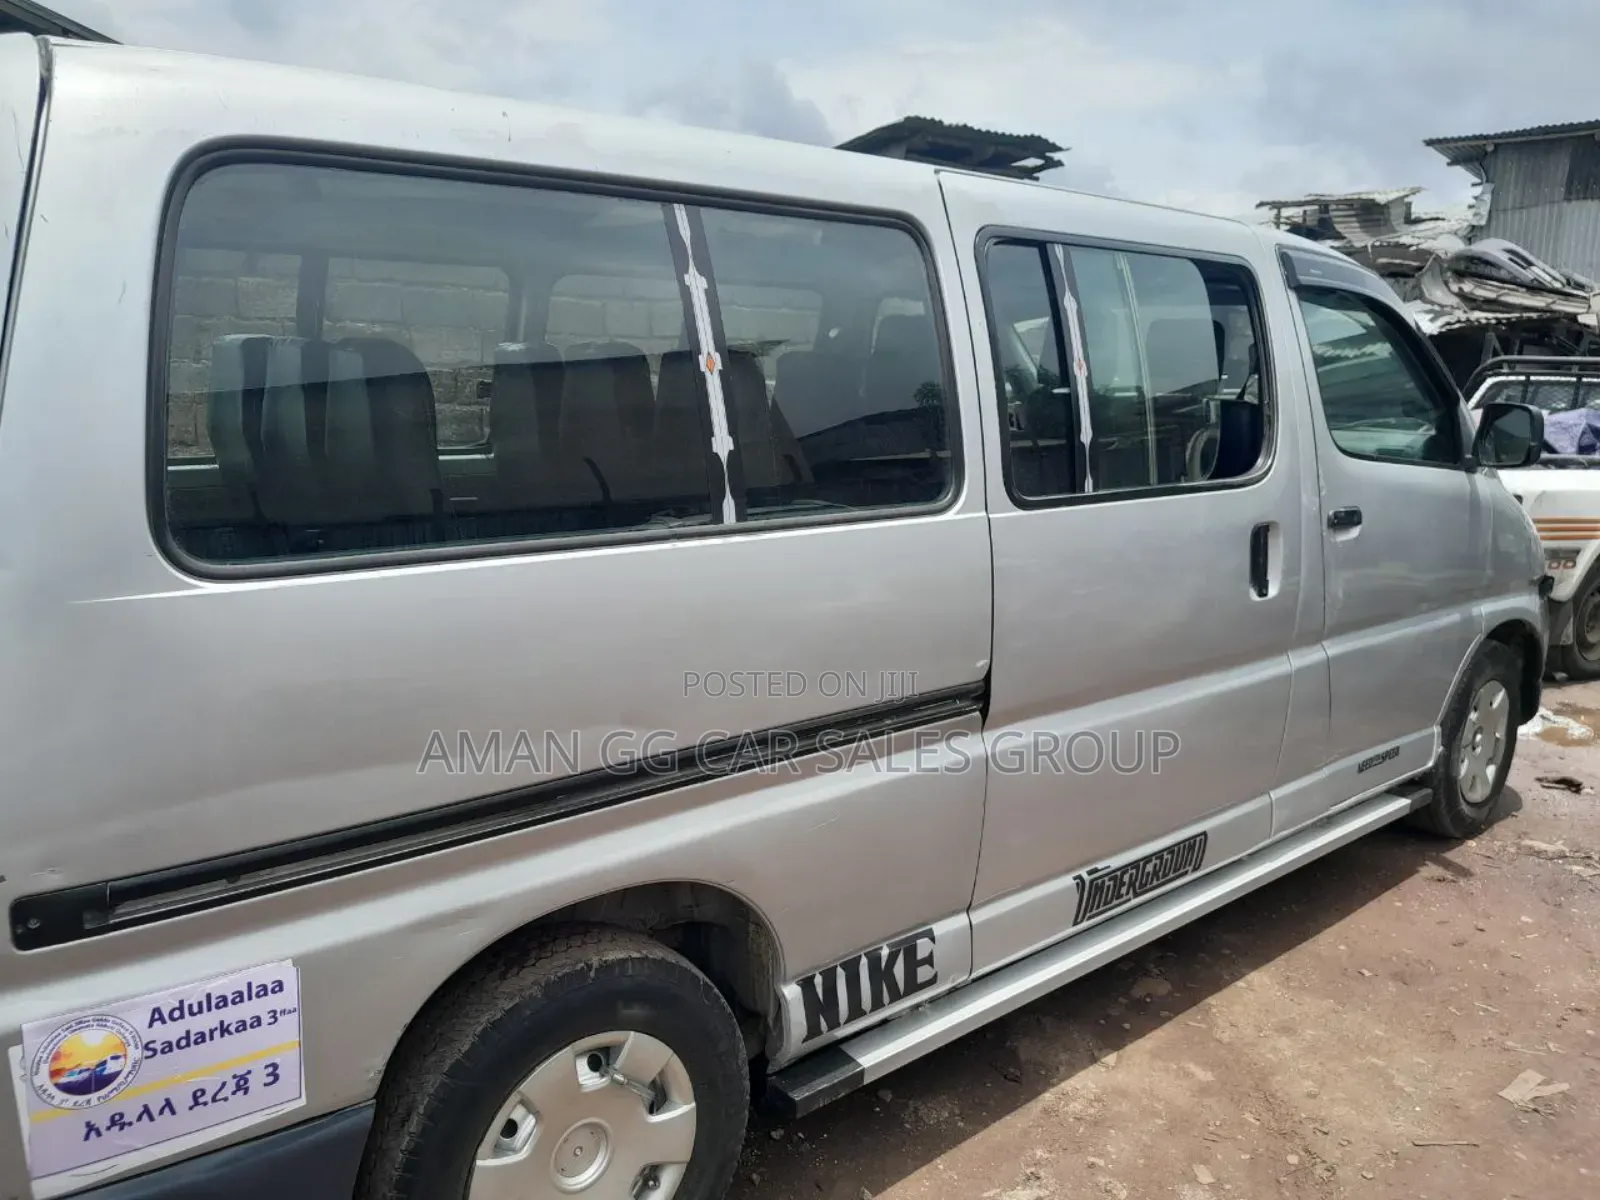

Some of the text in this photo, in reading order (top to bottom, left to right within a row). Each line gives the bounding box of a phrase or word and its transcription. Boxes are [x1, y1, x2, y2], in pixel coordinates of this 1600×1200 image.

[147, 979, 284, 1029] Adulaalaa
[796, 927, 938, 1044] NIKE
[143, 1014, 262, 1059] Sadarkaa
[188, 1069, 252, 1111] ደረጃ
[263, 1061, 281, 1087] 3
